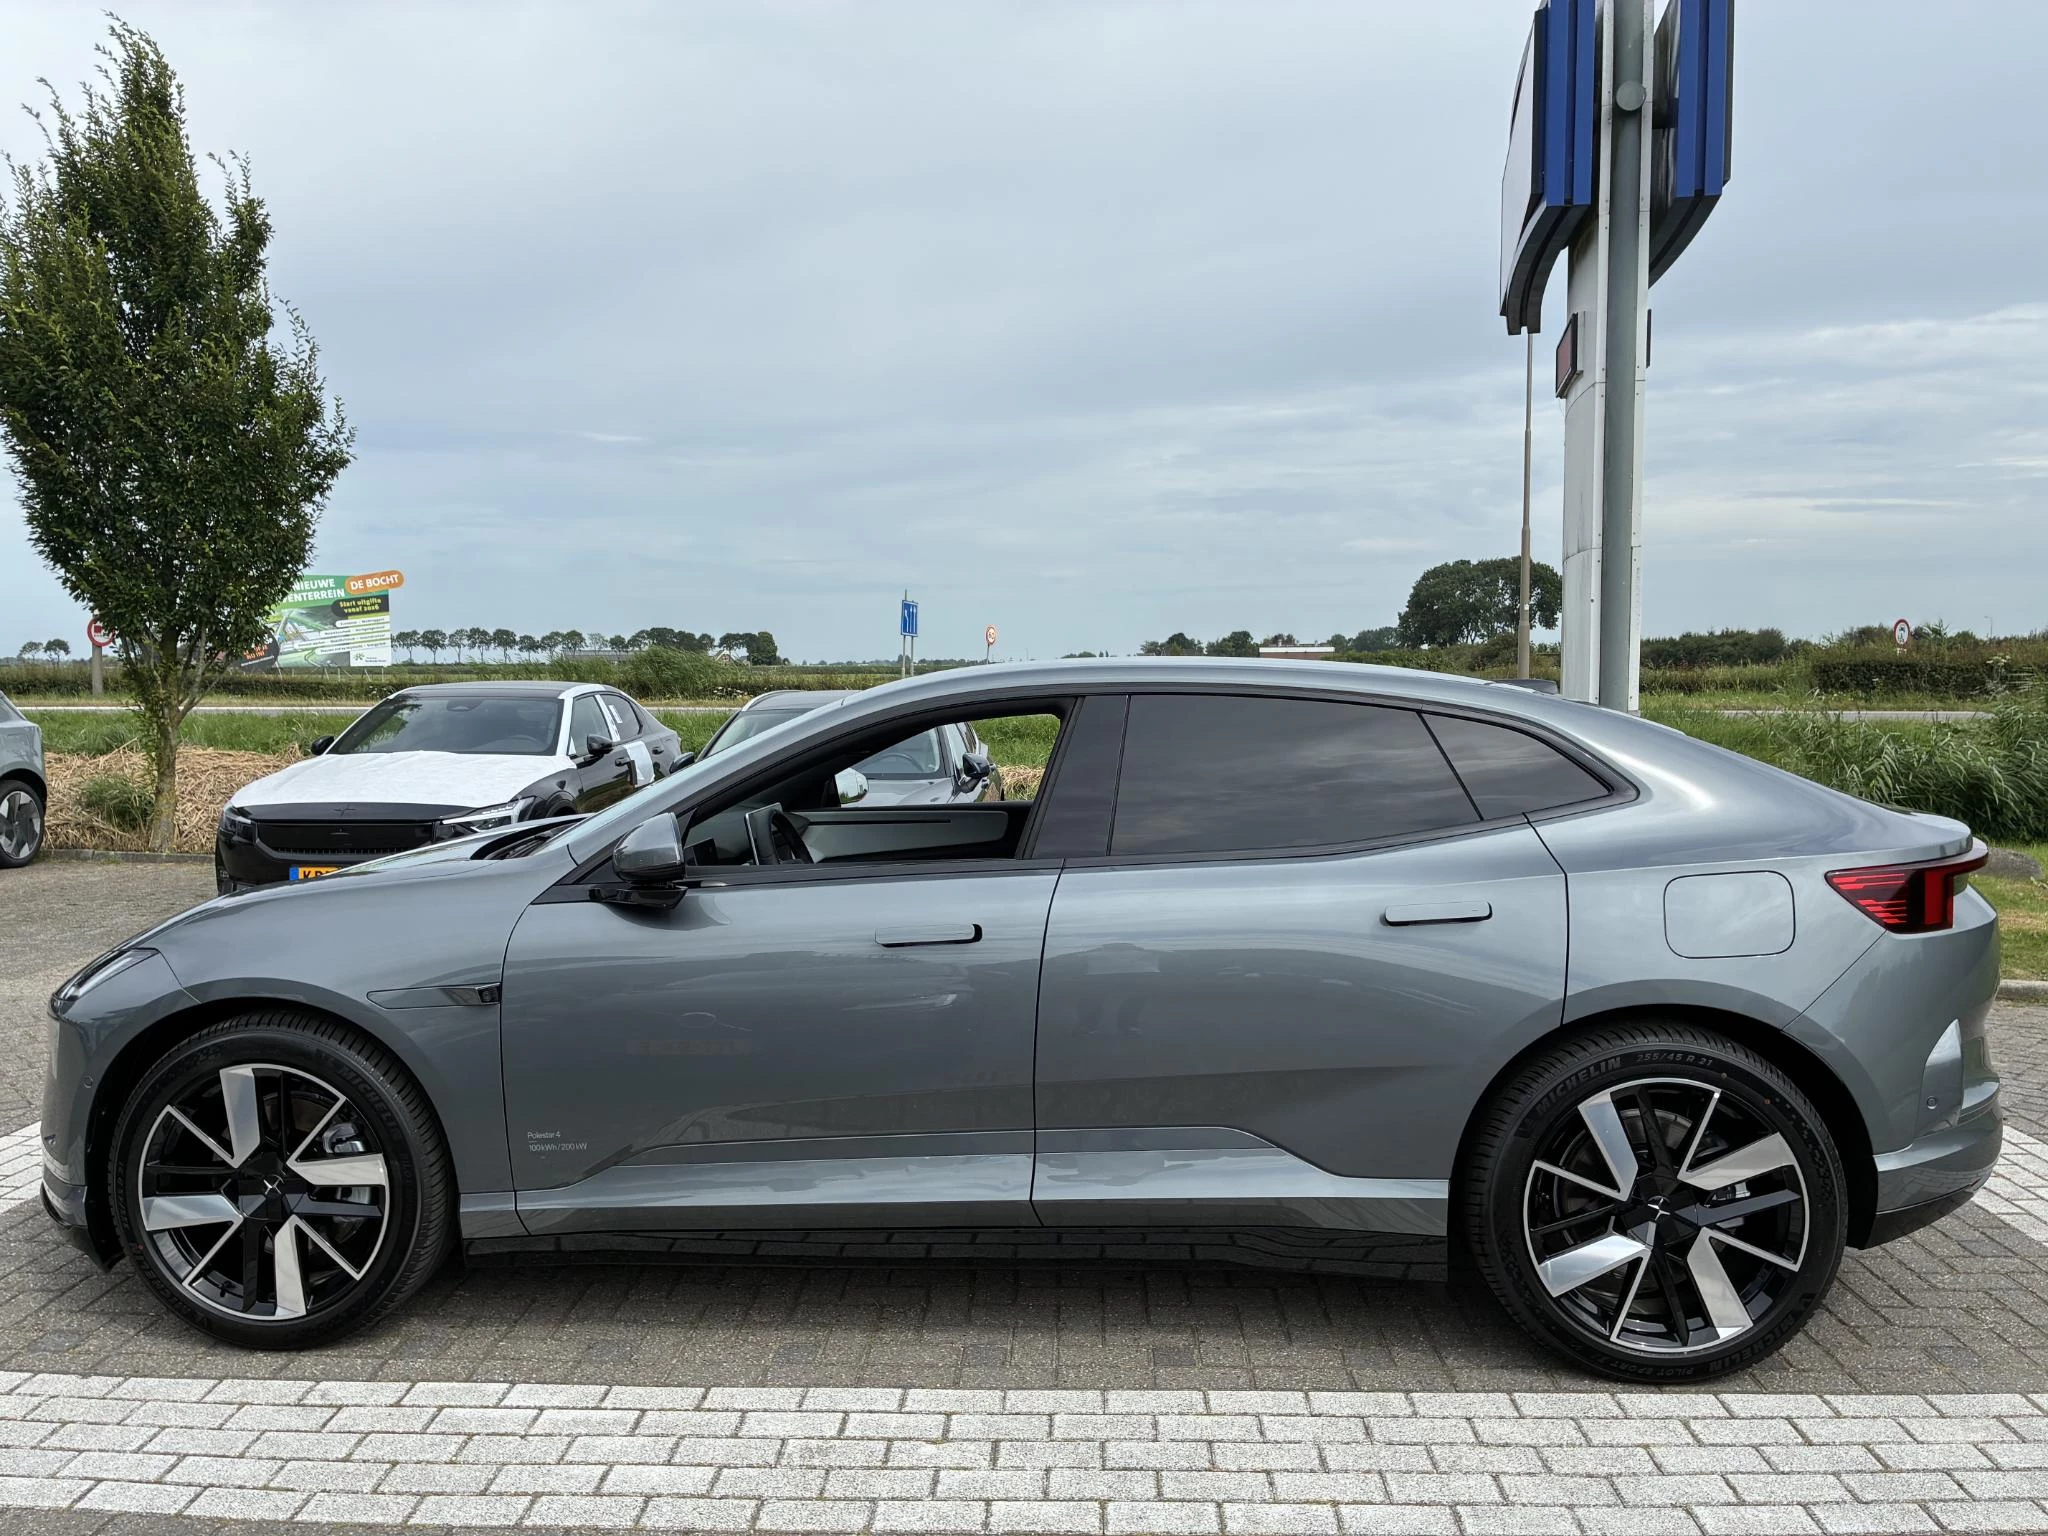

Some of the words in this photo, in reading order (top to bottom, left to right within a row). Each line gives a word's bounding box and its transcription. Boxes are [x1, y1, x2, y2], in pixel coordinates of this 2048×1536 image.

[292, 578, 336, 591] NIEUWE
[350, 580, 364, 590] DE
[366, 574, 399, 588] BOCHT
[1636, 1052, 1683, 1064] 255/45
[1686, 1053, 1696, 1063] R
[1536, 1056, 1622, 1114] MICHELIN
[555, 1130, 561, 1138] 4
[1707, 1314, 1796, 1373] MICHELIN
